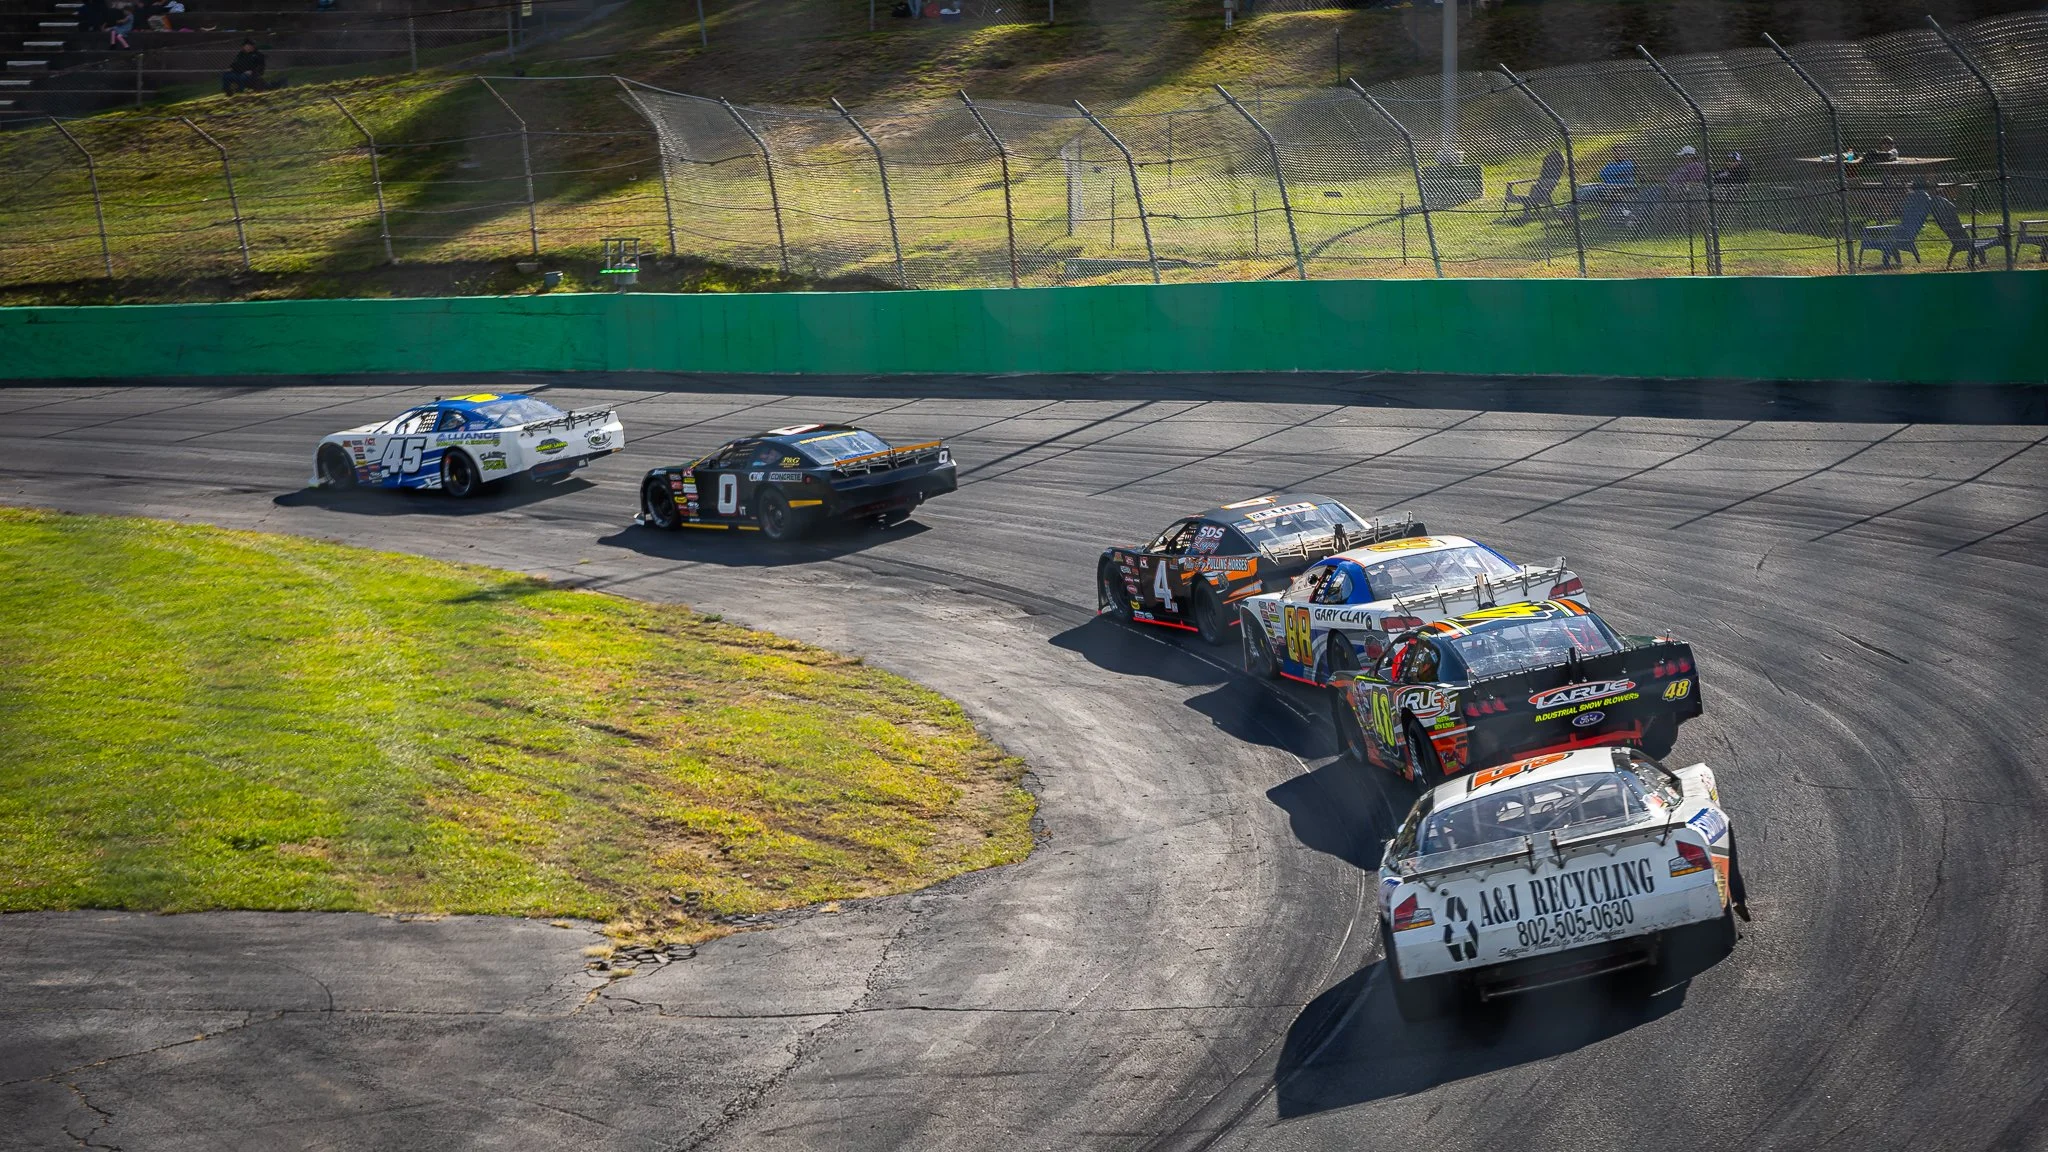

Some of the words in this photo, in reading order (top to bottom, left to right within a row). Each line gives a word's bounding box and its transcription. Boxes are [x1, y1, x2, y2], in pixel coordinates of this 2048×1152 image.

[381, 436, 427, 474] 45
[436, 432, 500, 447] ALLIANCE
[938, 449, 949, 464] 0
[770, 472, 802, 482] CONCRETE
[718, 473, 738, 514] 0
[1199, 526, 1226, 539] SDS
[1207, 558, 1228, 571] PULLING
[1228, 558, 1248, 571] HORSES
[1154, 559, 1173, 609] 4
[1314, 608, 1340, 621] GARY
[1339, 610, 1368, 624] CLAY
[1284, 605, 1314, 667] 88
[1535, 678, 1630, 709] LARUE
[1662, 680, 1690, 700] 48
[1535, 706, 1578, 723] INDUSTRIAL
[1578, 700, 1602, 712] SNOW
[1603, 692, 1640, 706] BLOWERS
[1479, 883, 1520, 928] A&J
[1528, 858, 1656, 917] RECYCLING
[1516, 898, 1634, 947] 802-505-0630
